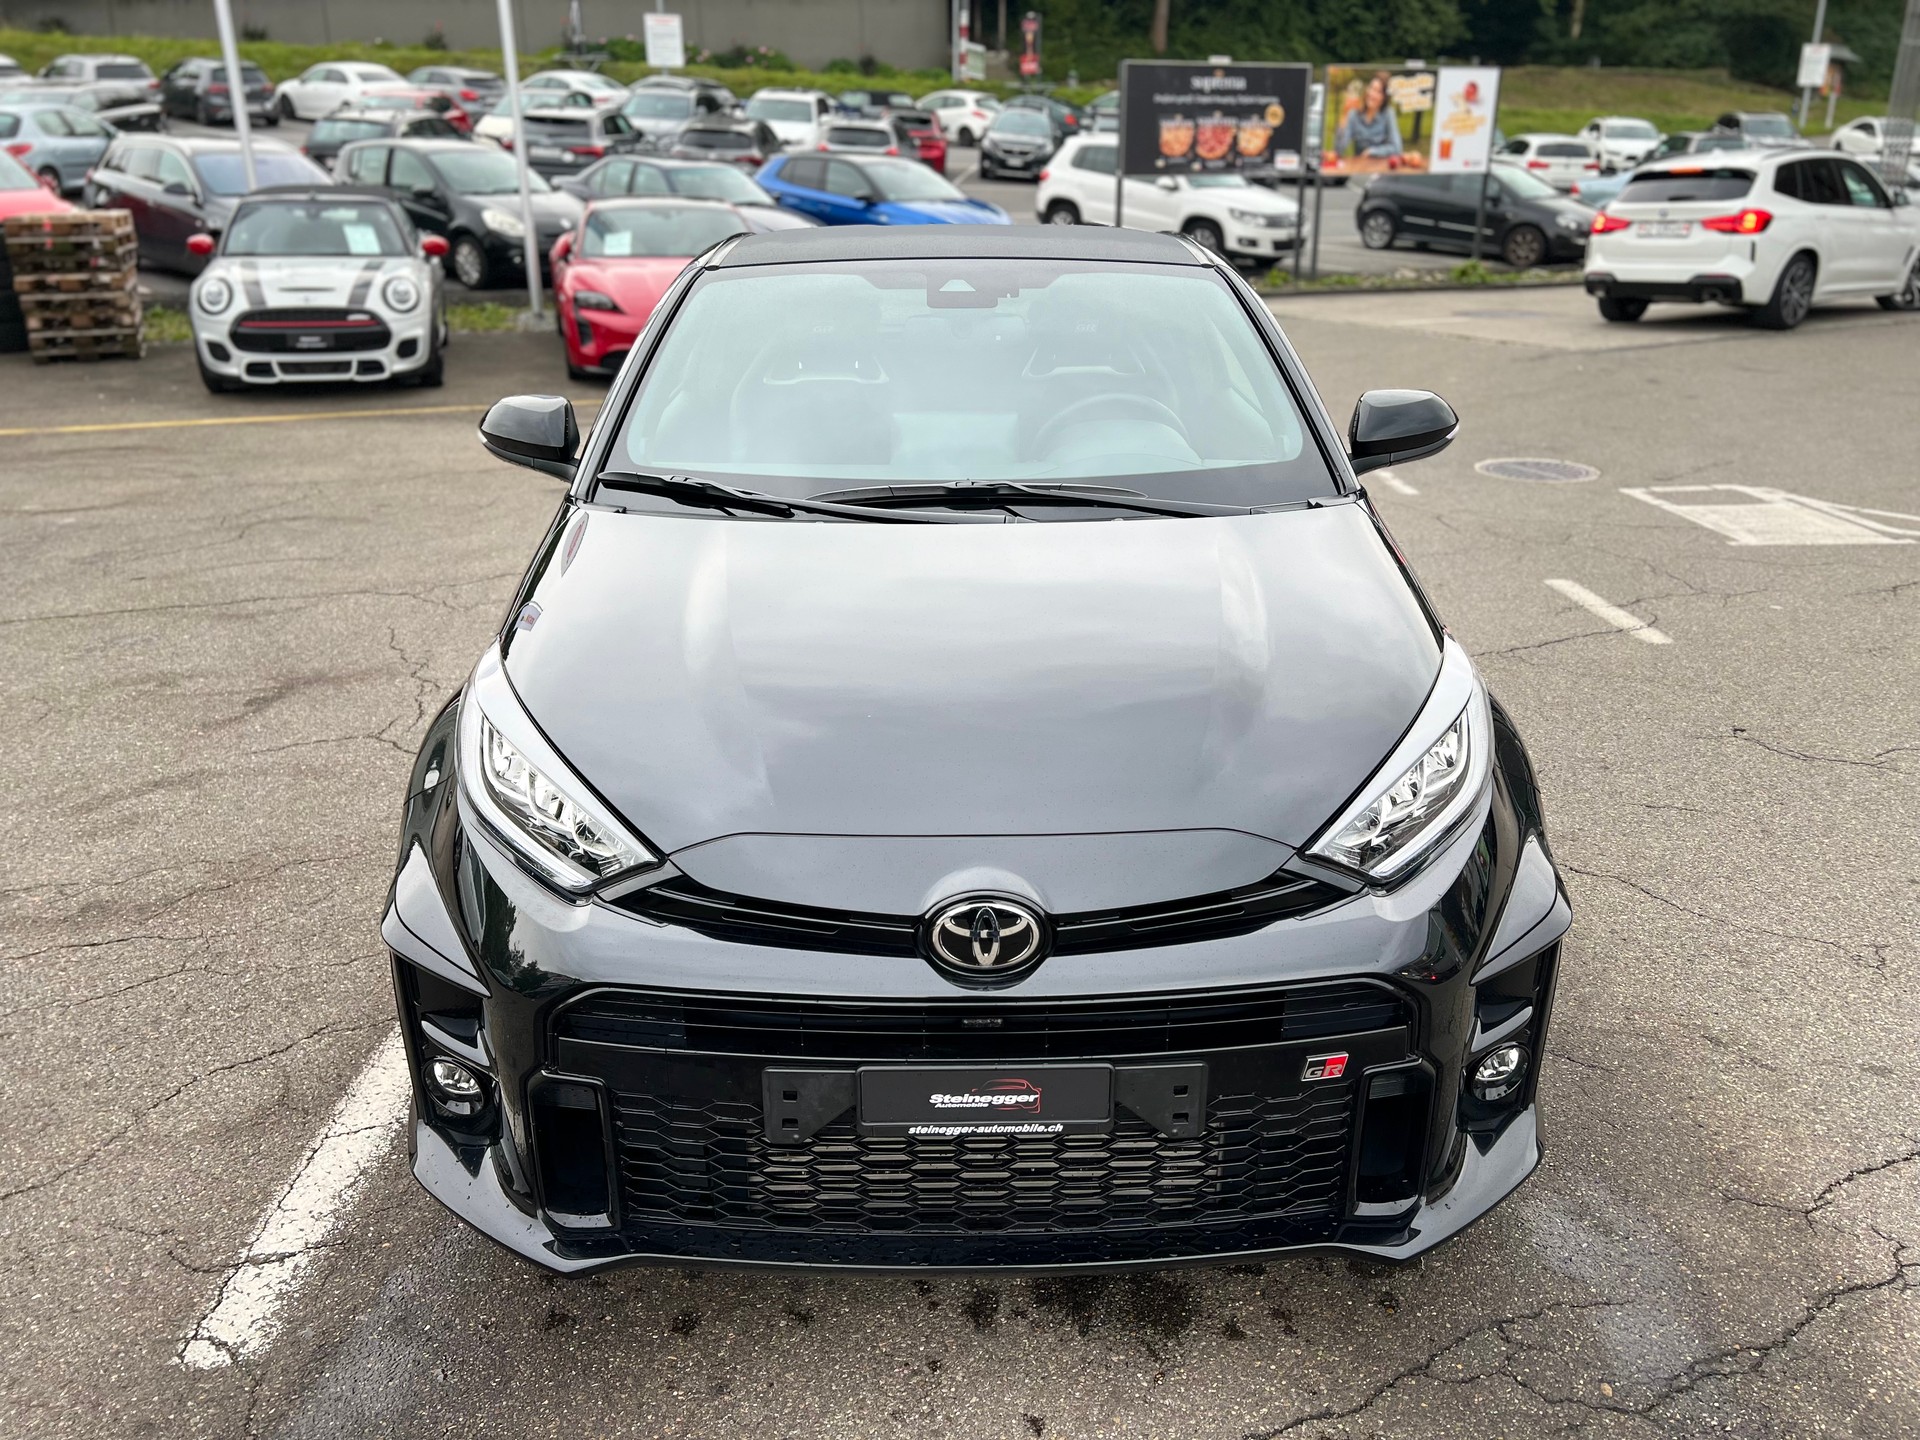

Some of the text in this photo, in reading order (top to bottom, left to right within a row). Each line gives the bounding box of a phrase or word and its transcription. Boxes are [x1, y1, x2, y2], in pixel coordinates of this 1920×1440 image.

[1305, 1064, 1343, 1078] GR
[929, 1093, 1039, 1105] Steinegger
[908, 1123, 1063, 1136] steinegger-automobile.ch
